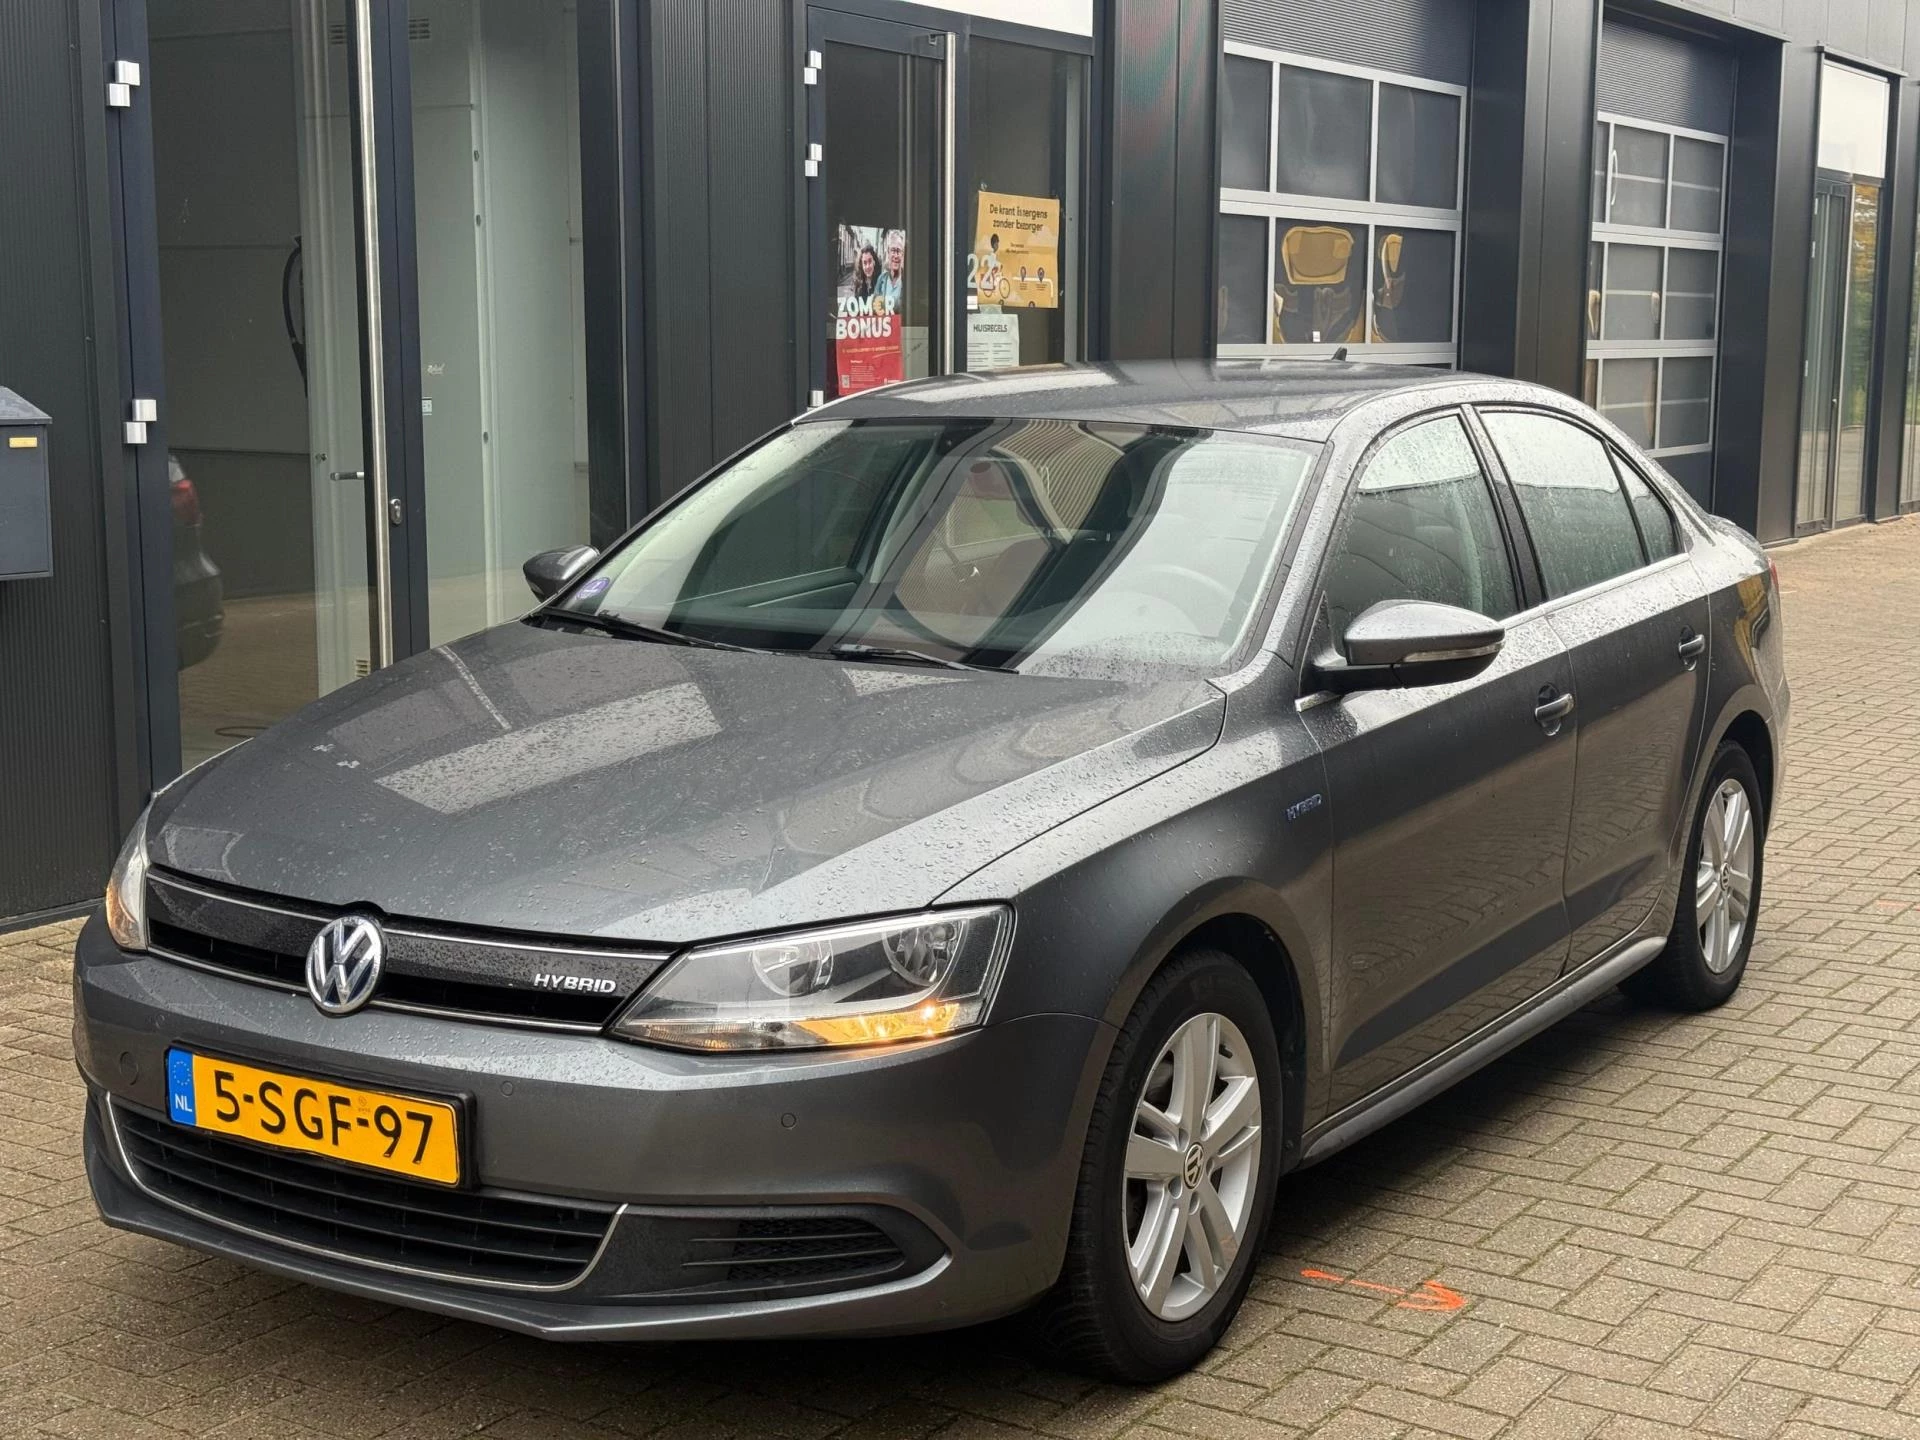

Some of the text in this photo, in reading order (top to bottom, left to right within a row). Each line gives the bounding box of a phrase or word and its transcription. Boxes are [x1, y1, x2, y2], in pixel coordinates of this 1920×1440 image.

[989, 203, 999, 214] De
[999, 204, 1015, 216] krant
[1022, 209, 1048, 220] nergens
[993, 218, 1044, 233] zonder bezorger
[836, 317, 892, 340] BONUS
[973, 323, 1008, 333] HUISREGELS
[1285, 793, 1322, 821] HYBRID
[533, 972, 617, 994] HYBRID
[174, 1093, 193, 1113] NL
[214, 1069, 433, 1165] 5-SGF-97
